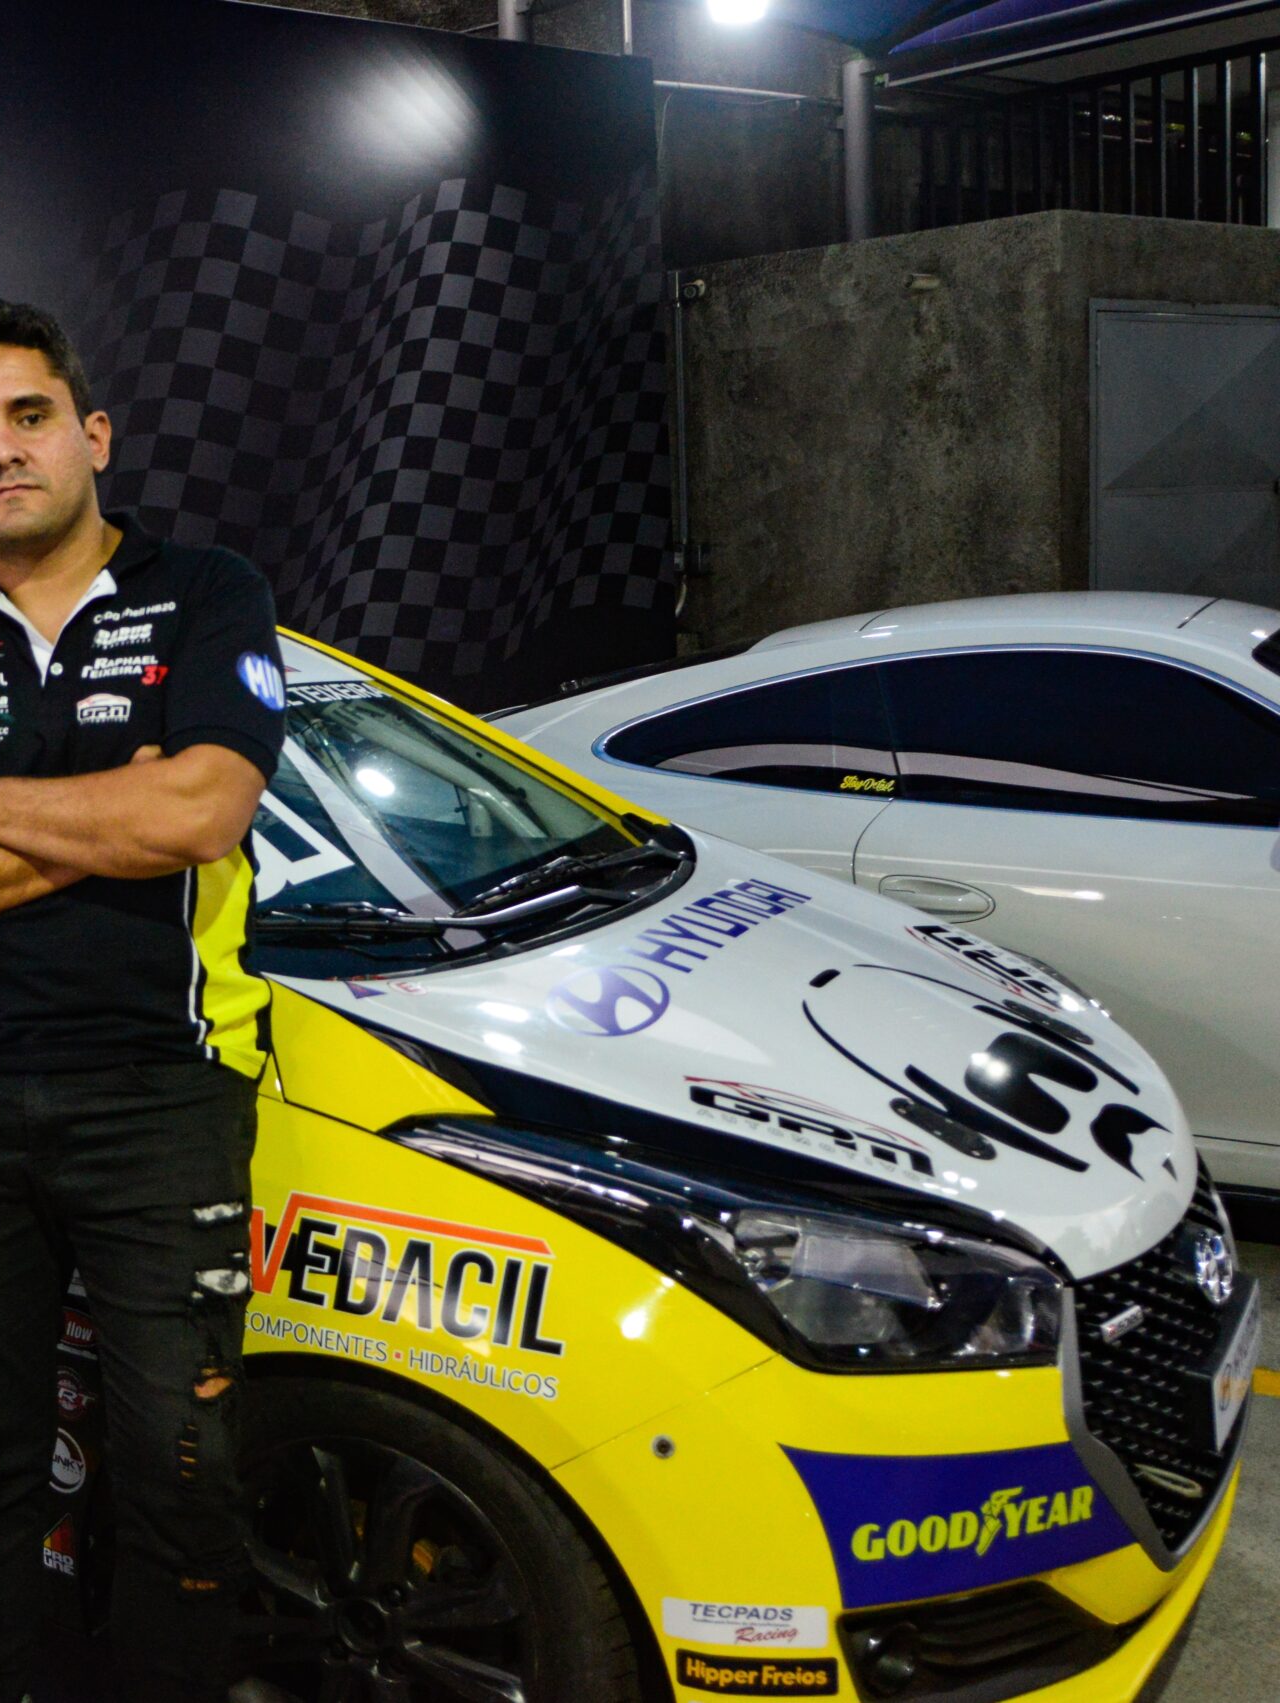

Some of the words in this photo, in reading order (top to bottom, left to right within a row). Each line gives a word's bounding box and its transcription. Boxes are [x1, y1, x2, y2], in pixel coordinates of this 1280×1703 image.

[141, 665, 169, 686] 37
[624, 878, 812, 974] HYUNDAI
[250, 1192, 564, 1356] VEDACIL
[409, 1348, 558, 1399] HIDRÁULICOS
[851, 1485, 1094, 1561] GOODYEAR
[689, 1603, 794, 1621] TECPADS
[735, 1626, 799, 1644] Racing
[686, 1657, 758, 1687] Hipper
[762, 1665, 828, 1686] Freios
